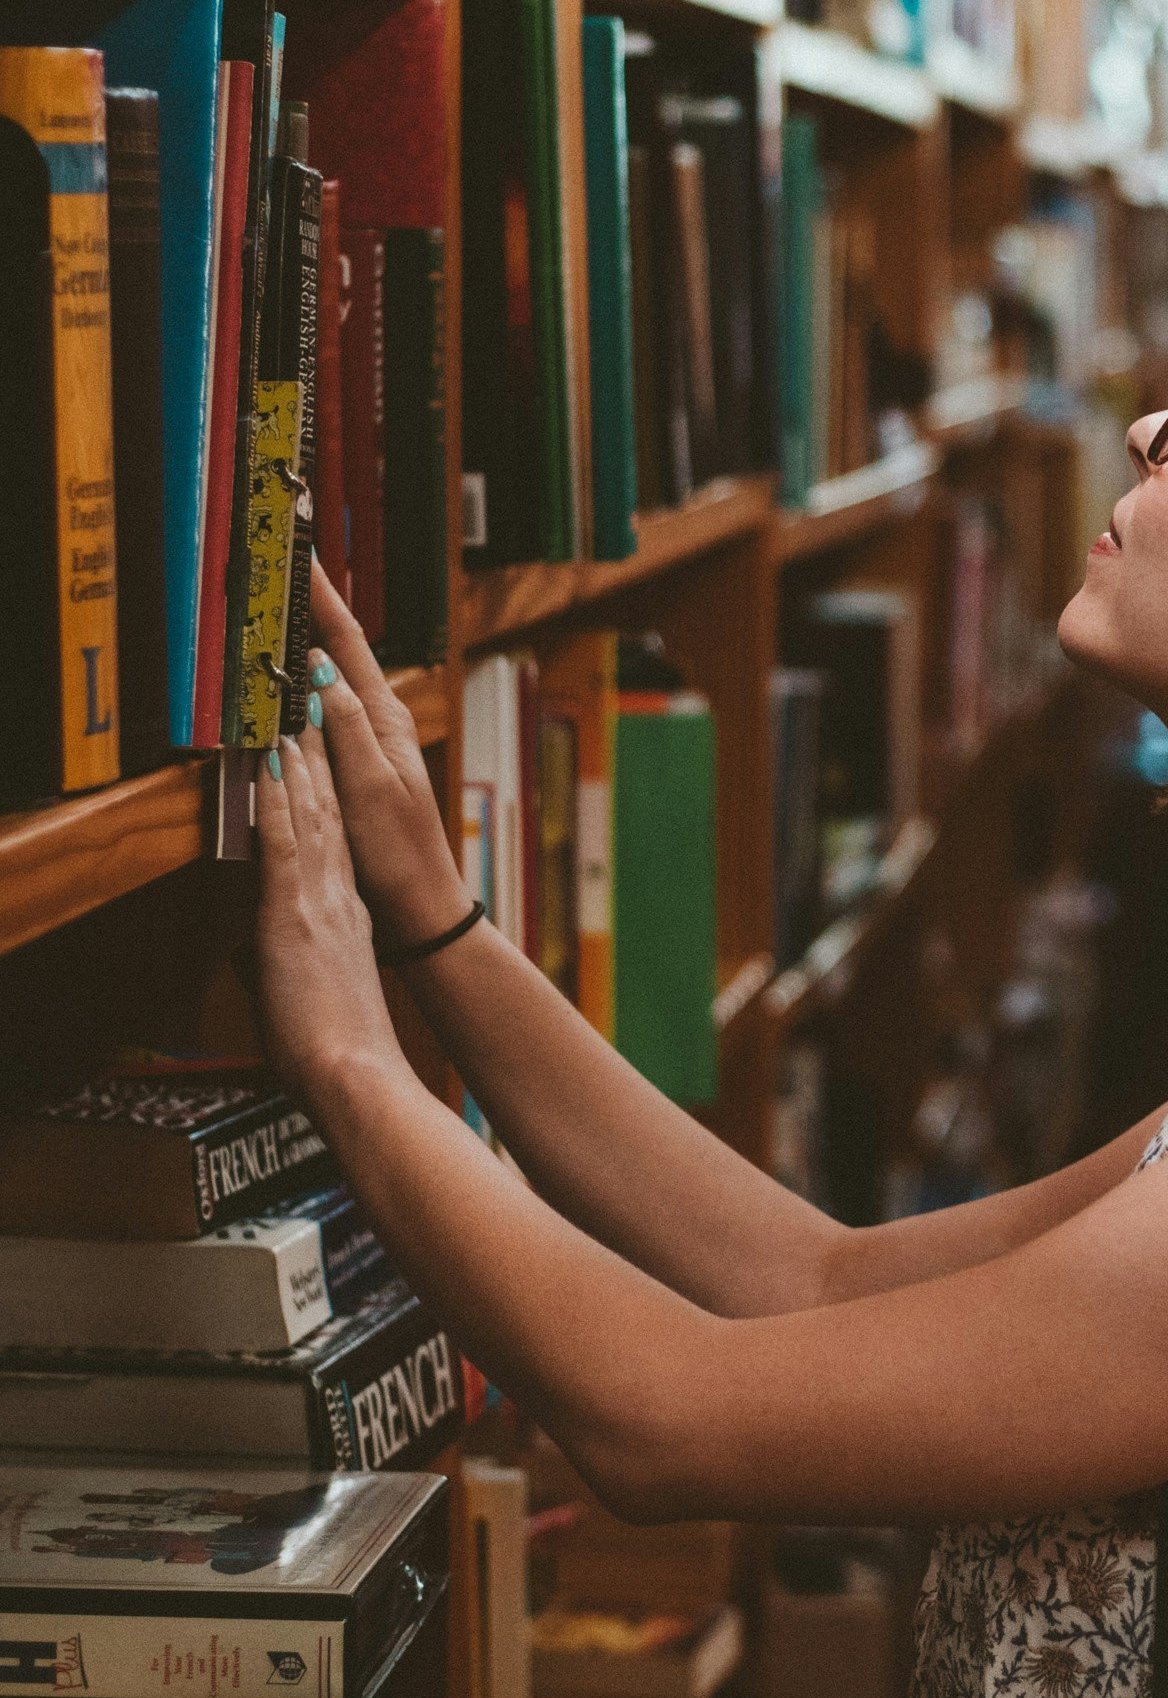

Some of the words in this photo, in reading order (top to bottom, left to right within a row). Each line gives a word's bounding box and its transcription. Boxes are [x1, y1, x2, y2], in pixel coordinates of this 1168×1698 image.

[83, 648, 112, 737] L
[208, 1123, 281, 1202] FRENCH
[352, 1331, 456, 1472] FRENCH
[186, 1651, 195, 1680] French
[221, 1655, 230, 1678] More
